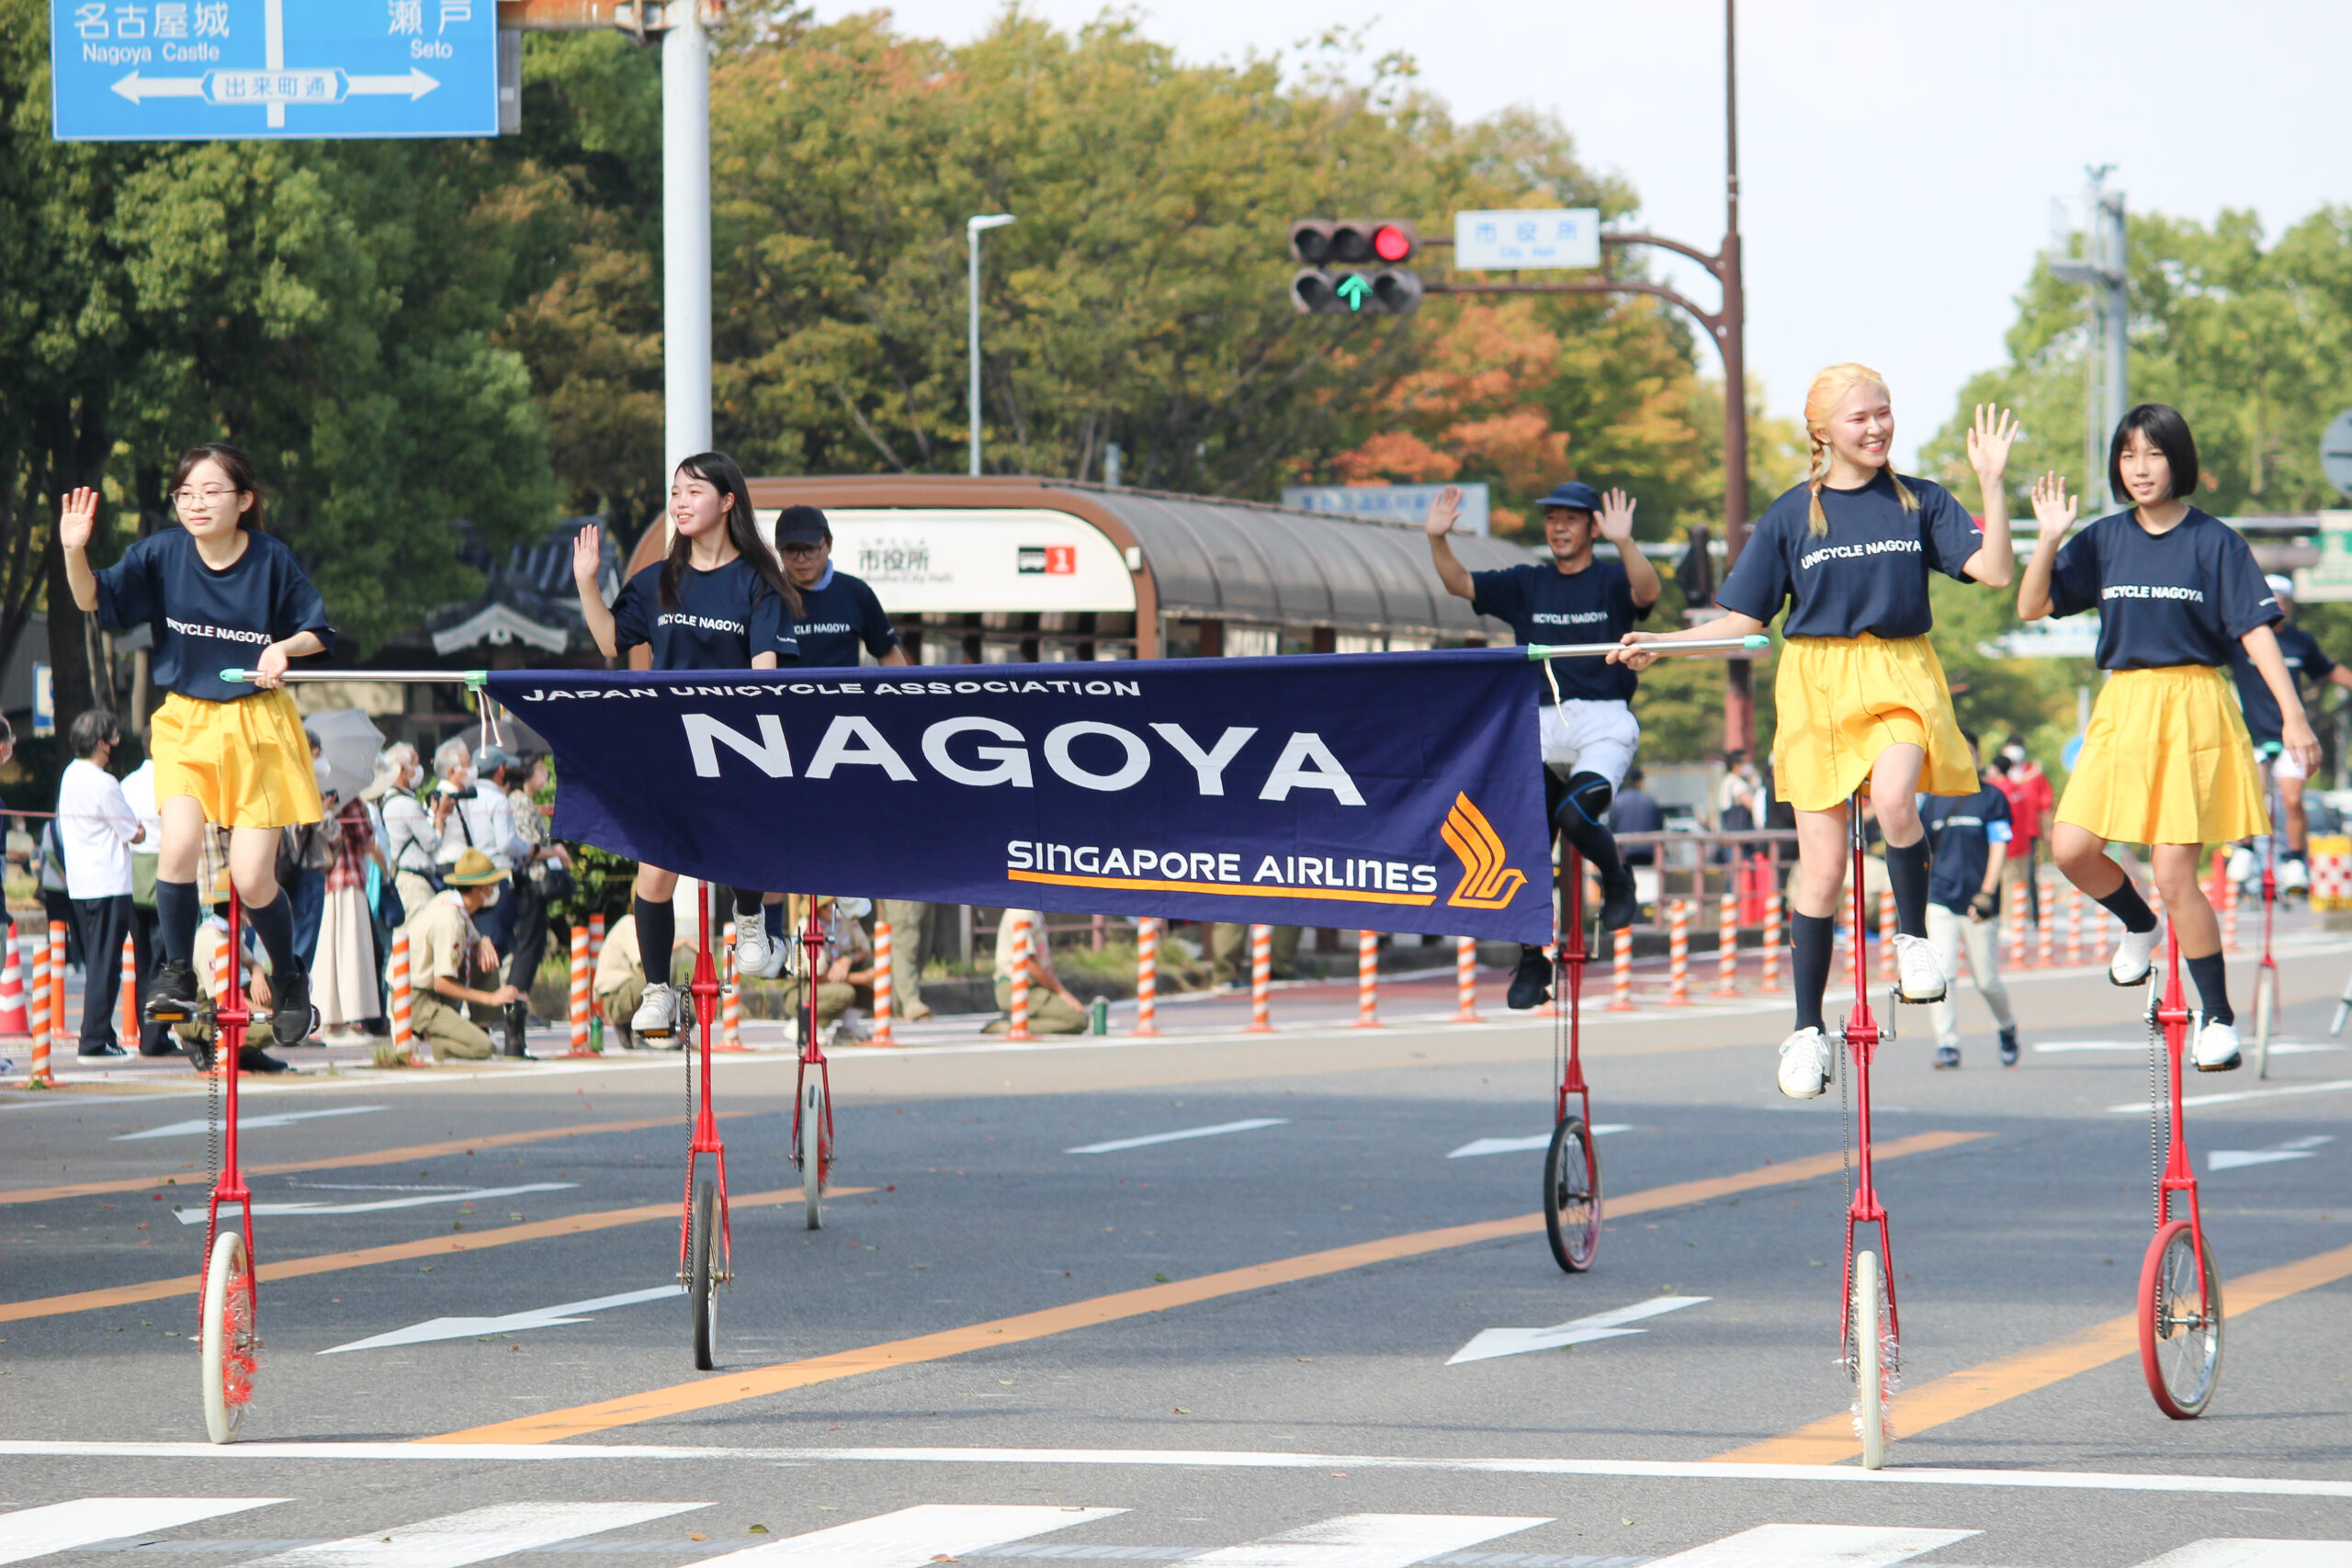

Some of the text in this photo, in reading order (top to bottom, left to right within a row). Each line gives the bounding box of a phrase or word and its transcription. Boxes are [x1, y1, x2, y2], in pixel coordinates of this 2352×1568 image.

[74, 2, 230, 39] 名古屋城
[388, 0, 472, 36] 瀬戸
[84, 42, 220, 65] Nagoya Castle
[410, 39, 453, 59] Seto
[225, 76, 326, 97] 出来町通
[1476, 220, 1578, 243] 市役所
[860, 549, 929, 571] 市役所
[1054, 548, 1069, 572] 1
[1801, 539, 1922, 570] UNICYCLE NAGOYA
[2151, 586, 2204, 603] NAGOYA
[698, 616, 744, 636] NAGOYA
[1570, 611, 1609, 624] NAGOYA
[216, 627, 273, 645] NAGOYA
[814, 623, 851, 635] NAGOYA
[522, 680, 1141, 701] JAPAN UNICYCLE ASSOCIATION
[681, 713, 1367, 807] NAGOYA
